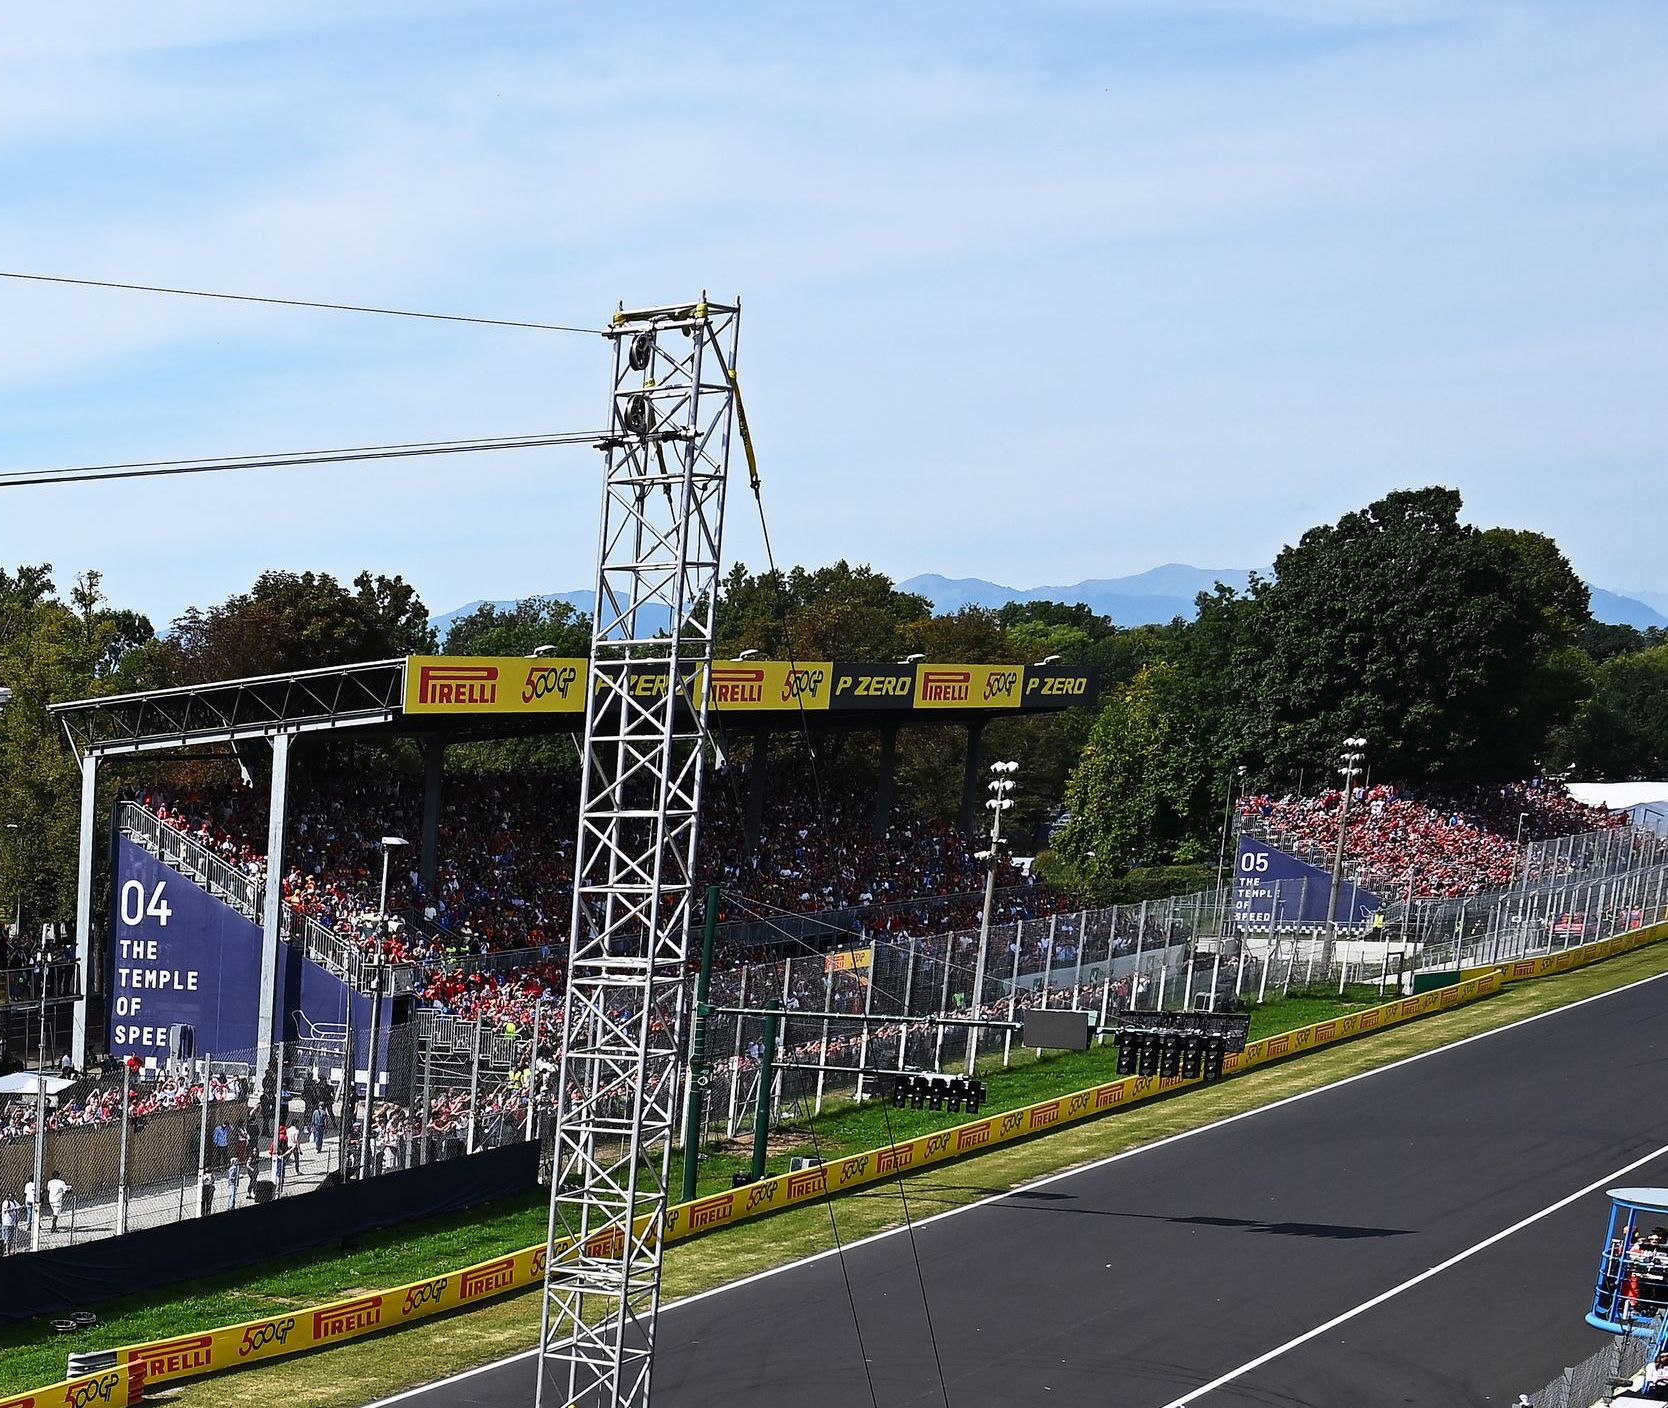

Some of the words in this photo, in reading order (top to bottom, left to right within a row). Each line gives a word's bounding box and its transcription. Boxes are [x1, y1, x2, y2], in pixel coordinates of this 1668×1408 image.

[419, 666, 499, 704] PIRELLI
[835, 677, 852, 695] P
[854, 677, 911, 695] ZERO
[923, 671, 970, 700] PIRELLI
[1026, 677, 1040, 695] P
[1041, 677, 1087, 695] ZERO
[1241, 852, 1269, 872] 05
[1239, 878, 1260, 886] THE
[121, 880, 172, 926] 04
[120, 939, 157, 960] THE
[118, 968, 198, 991] TEMPLE
[116, 997, 141, 1016] OF
[115, 1024, 168, 1047] SPEE
[128, 1336, 213, 1385] PRELLI
[313, 1296, 382, 1339] PIRELLI
[461, 1260, 514, 1299] PIRELLI
[689, 1194, 733, 1228] PIRELLI
[787, 1168, 827, 1198] PIRELLI
[878, 1144, 913, 1173] PIRELLI
[957, 1122, 991, 1150] PIRELLI
[1030, 1102, 1060, 1128] PIRELLI
[1096, 1082, 1125, 1107] PIRELLI
[1267, 1036, 1289, 1057] PIRELLI
